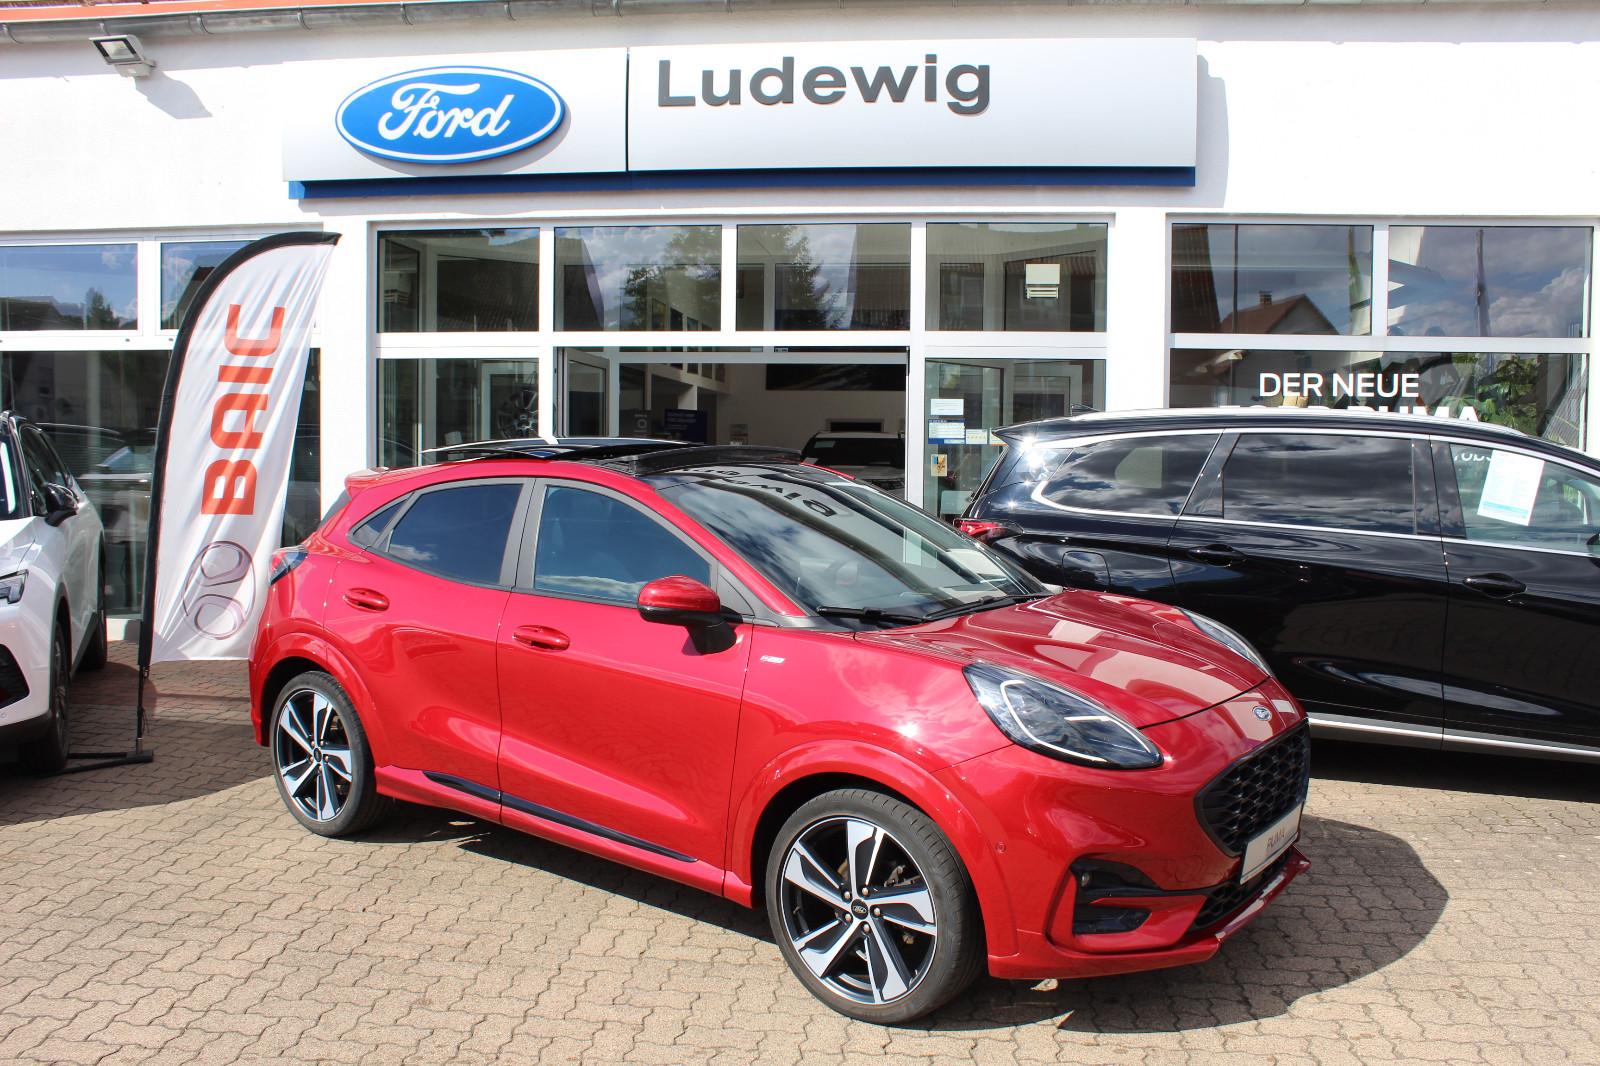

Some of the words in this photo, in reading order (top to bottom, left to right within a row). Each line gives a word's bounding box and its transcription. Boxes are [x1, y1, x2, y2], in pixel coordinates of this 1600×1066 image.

[377, 82, 516, 141] Ford
[657, 53, 991, 115] Ludewig
[200, 303, 286, 516] BAIC
[1259, 372, 1324, 397] DER
[1332, 373, 1420, 398] NEUE
